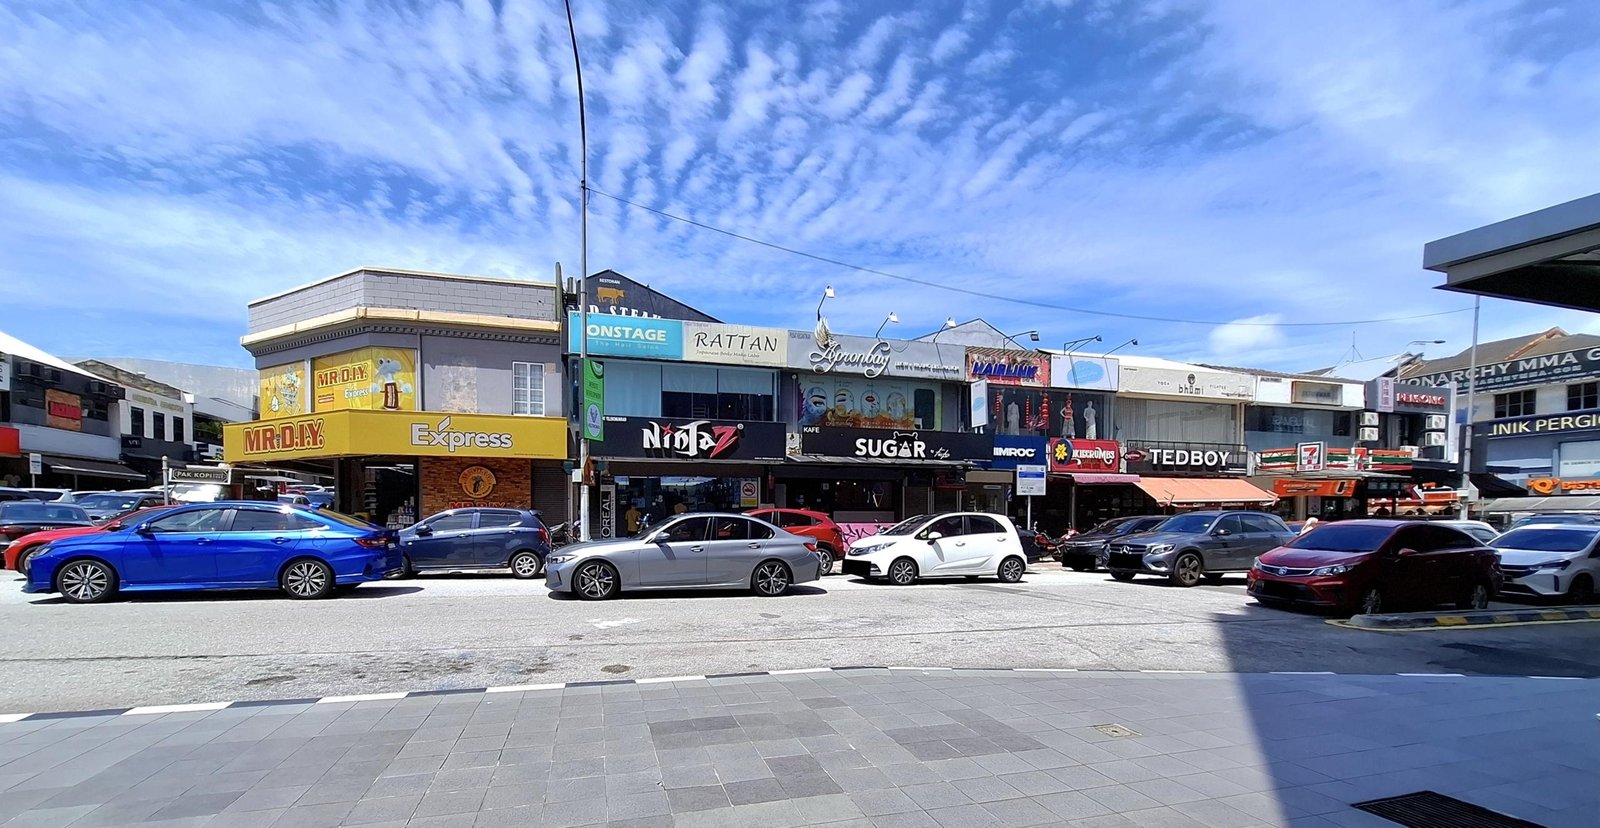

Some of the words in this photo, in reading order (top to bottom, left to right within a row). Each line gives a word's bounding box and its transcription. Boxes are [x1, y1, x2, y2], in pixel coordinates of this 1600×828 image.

[587, 324, 667, 342] ONSTAGE
[694, 332, 777, 352] RATTAN
[809, 339, 890, 378] Apronbay
[1518, 352, 1579, 372] MMA
[1587, 347, 1600, 360] G
[411, 416, 513, 452] Express
[1487, 420, 1532, 436] INIK
[1535, 414, 1600, 431] PERGI
[244, 427, 277, 453] MR
[855, 438, 926, 459] SUGAR
[1149, 449, 1230, 467] TEDBOY
